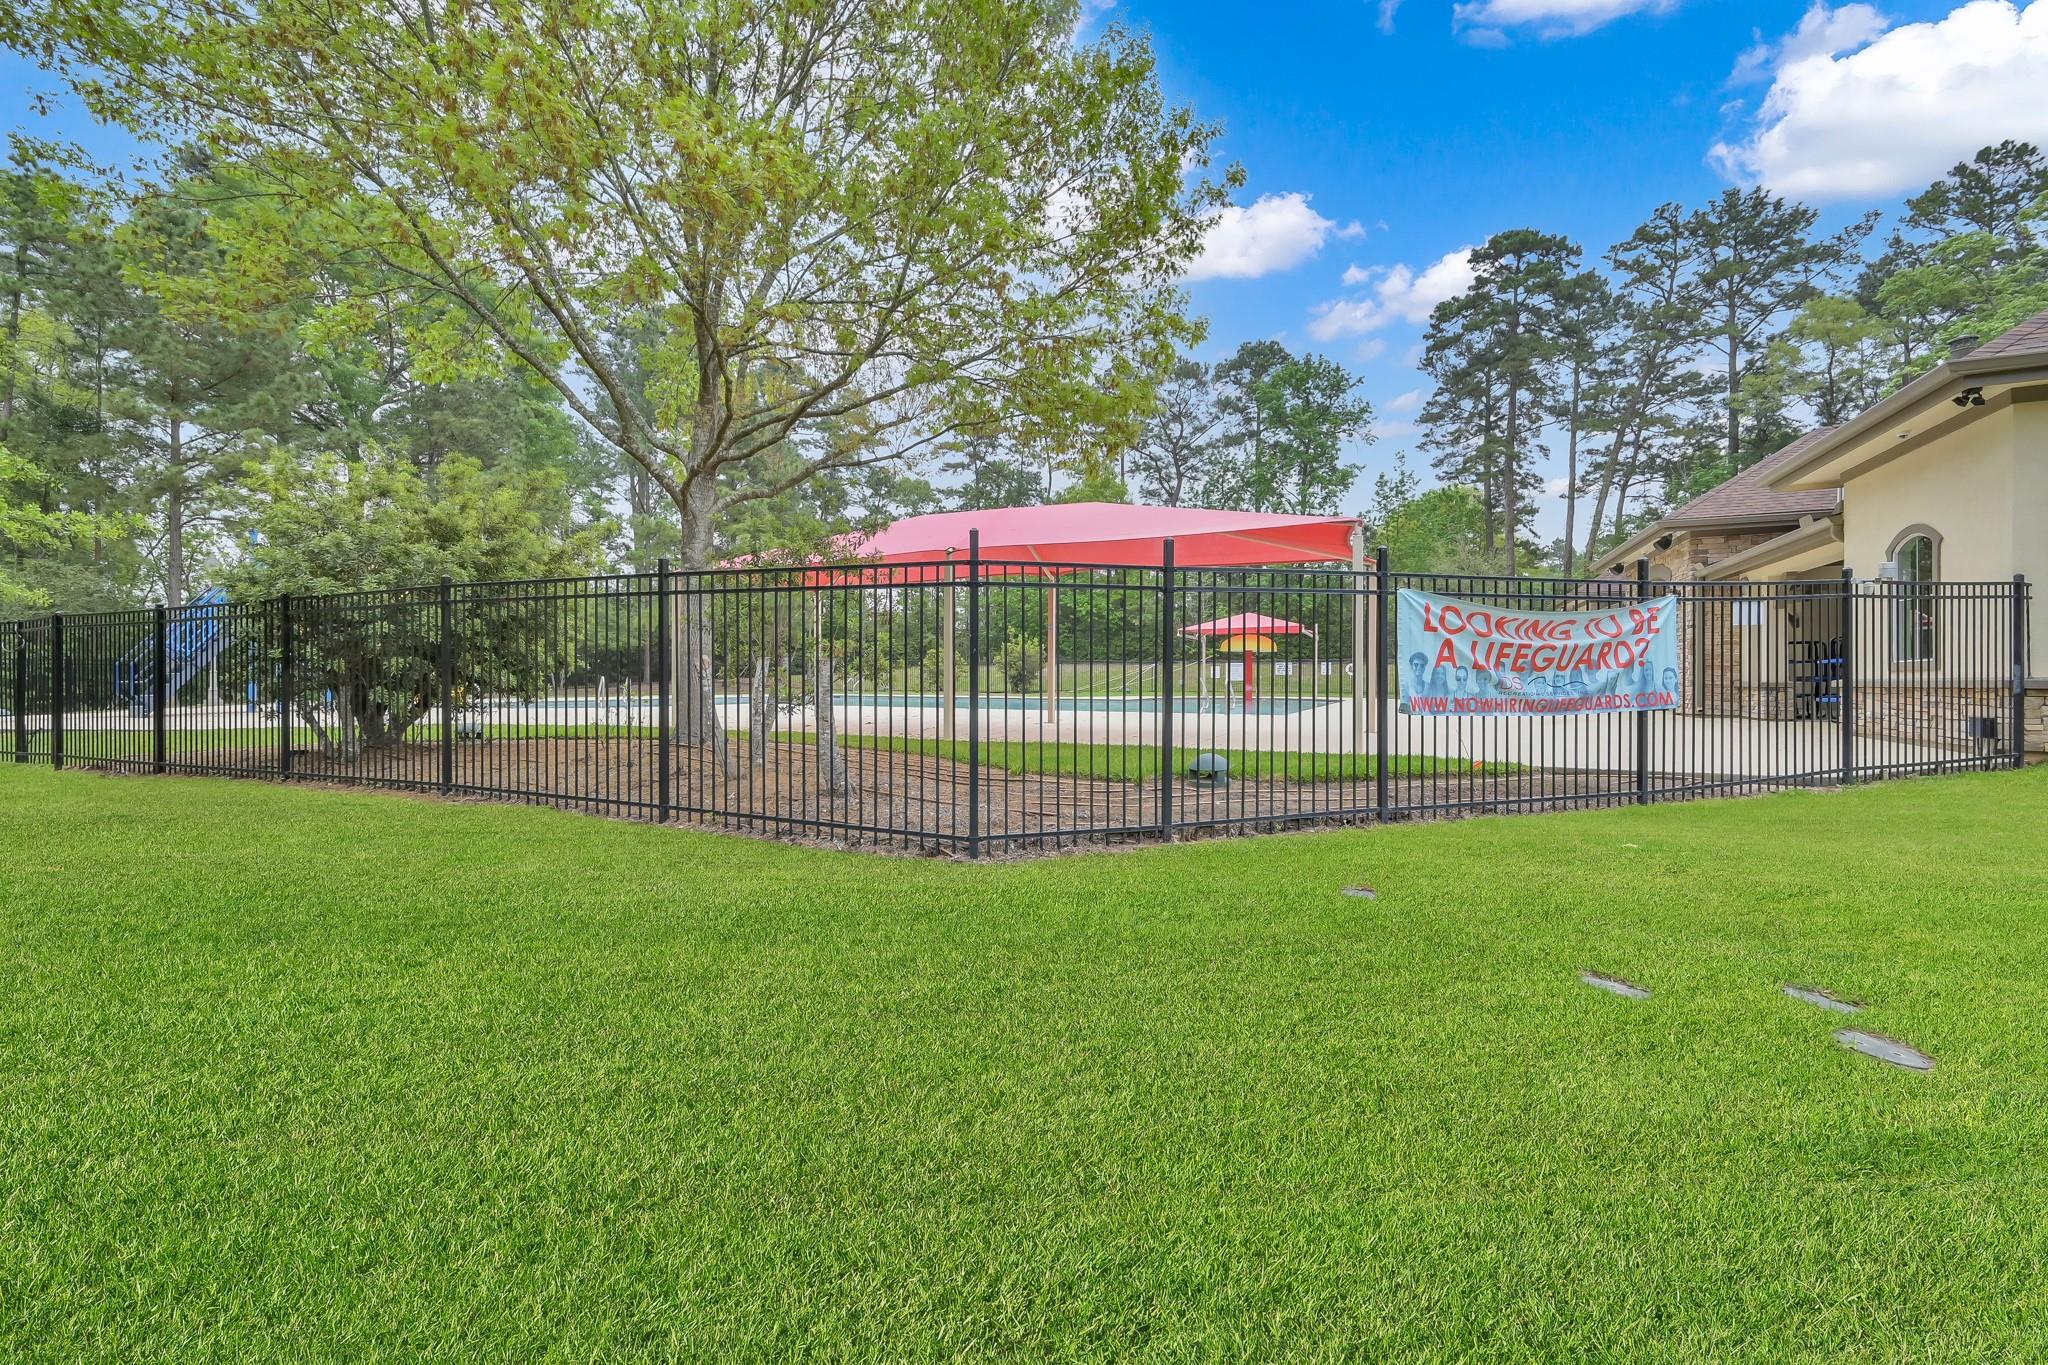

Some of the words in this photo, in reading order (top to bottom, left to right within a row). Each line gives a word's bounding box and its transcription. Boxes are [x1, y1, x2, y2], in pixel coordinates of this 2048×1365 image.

[1423, 602, 1577, 641] LOOKING
[1584, 614, 1624, 640] TO
[1628, 607, 1661, 635] BE
[1434, 638, 1457, 669] A
[1470, 638, 1650, 673] LIFEGUARD?
[1409, 691, 1675, 713] WWW.NOWHIRINGLIFEGUARDS.COM
